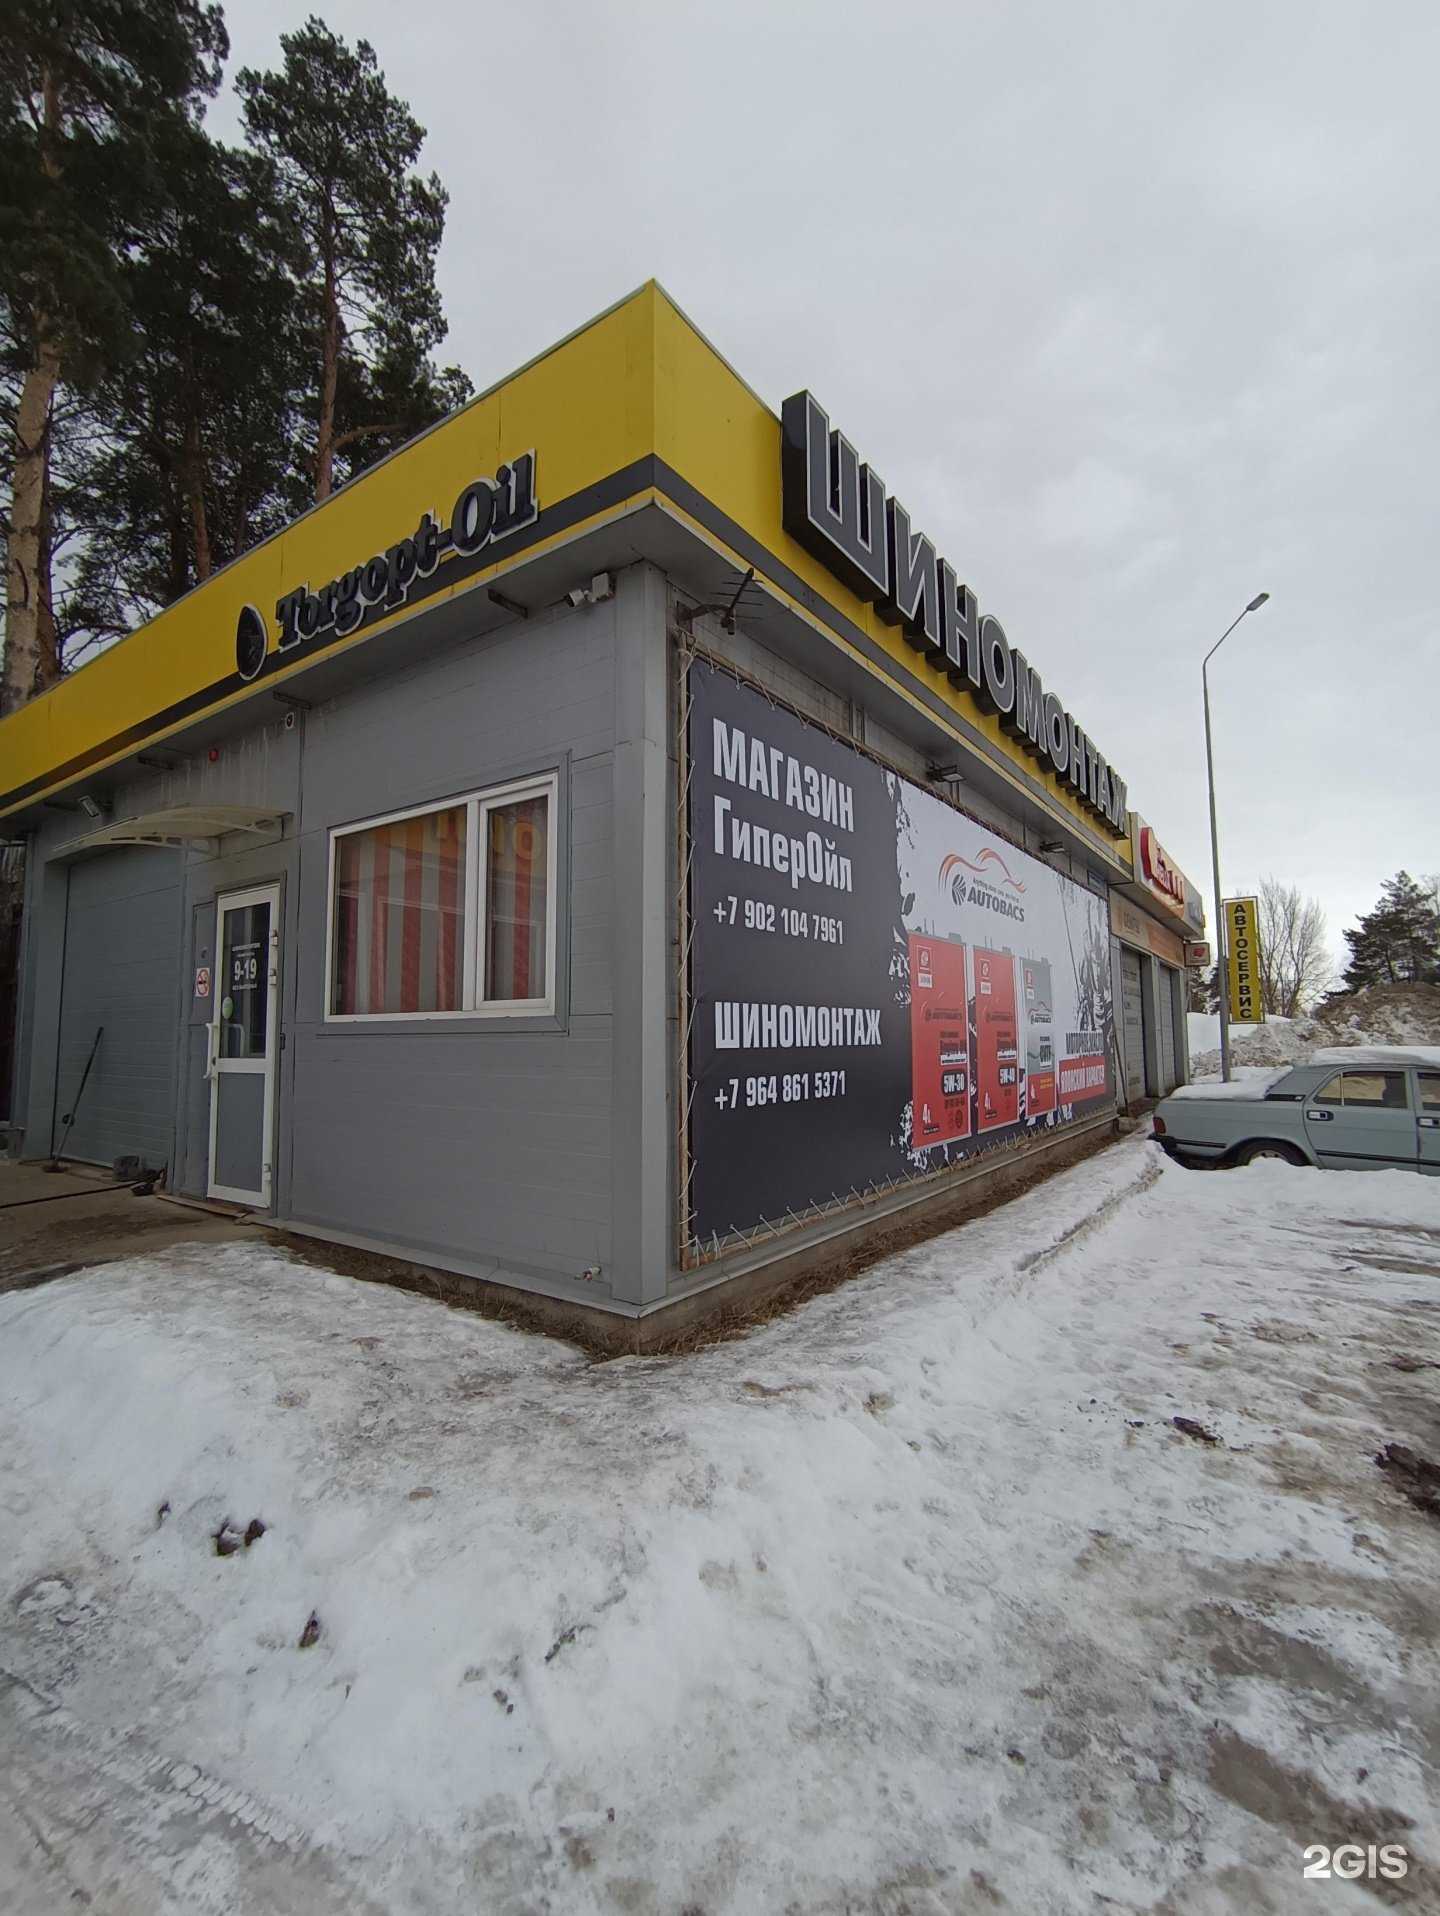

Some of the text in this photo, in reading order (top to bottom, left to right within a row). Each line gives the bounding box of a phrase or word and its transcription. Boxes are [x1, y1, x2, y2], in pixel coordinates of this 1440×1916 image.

[276, 448, 538, 653] Torgopt-Oil
[783, 390, 1128, 839] ШИНОМОНТАЖ
[713, 718, 854, 832] МАГАЗИН
[714, 795, 853, 892] ГиперОйл
[713, 895, 843, 945] +7 902 104 7961
[967, 886, 1025, 922] AUTOBACS
[234, 958, 257, 981] 9-19
[1234, 904, 1252, 1018] АВТОСЕРВИС
[715, 1001, 882, 1049] ШИНОМОНТАЖ
[714, 1070, 846, 1110] +7 964 861 5371
[943, 1073, 965, 1094] 5W-30
